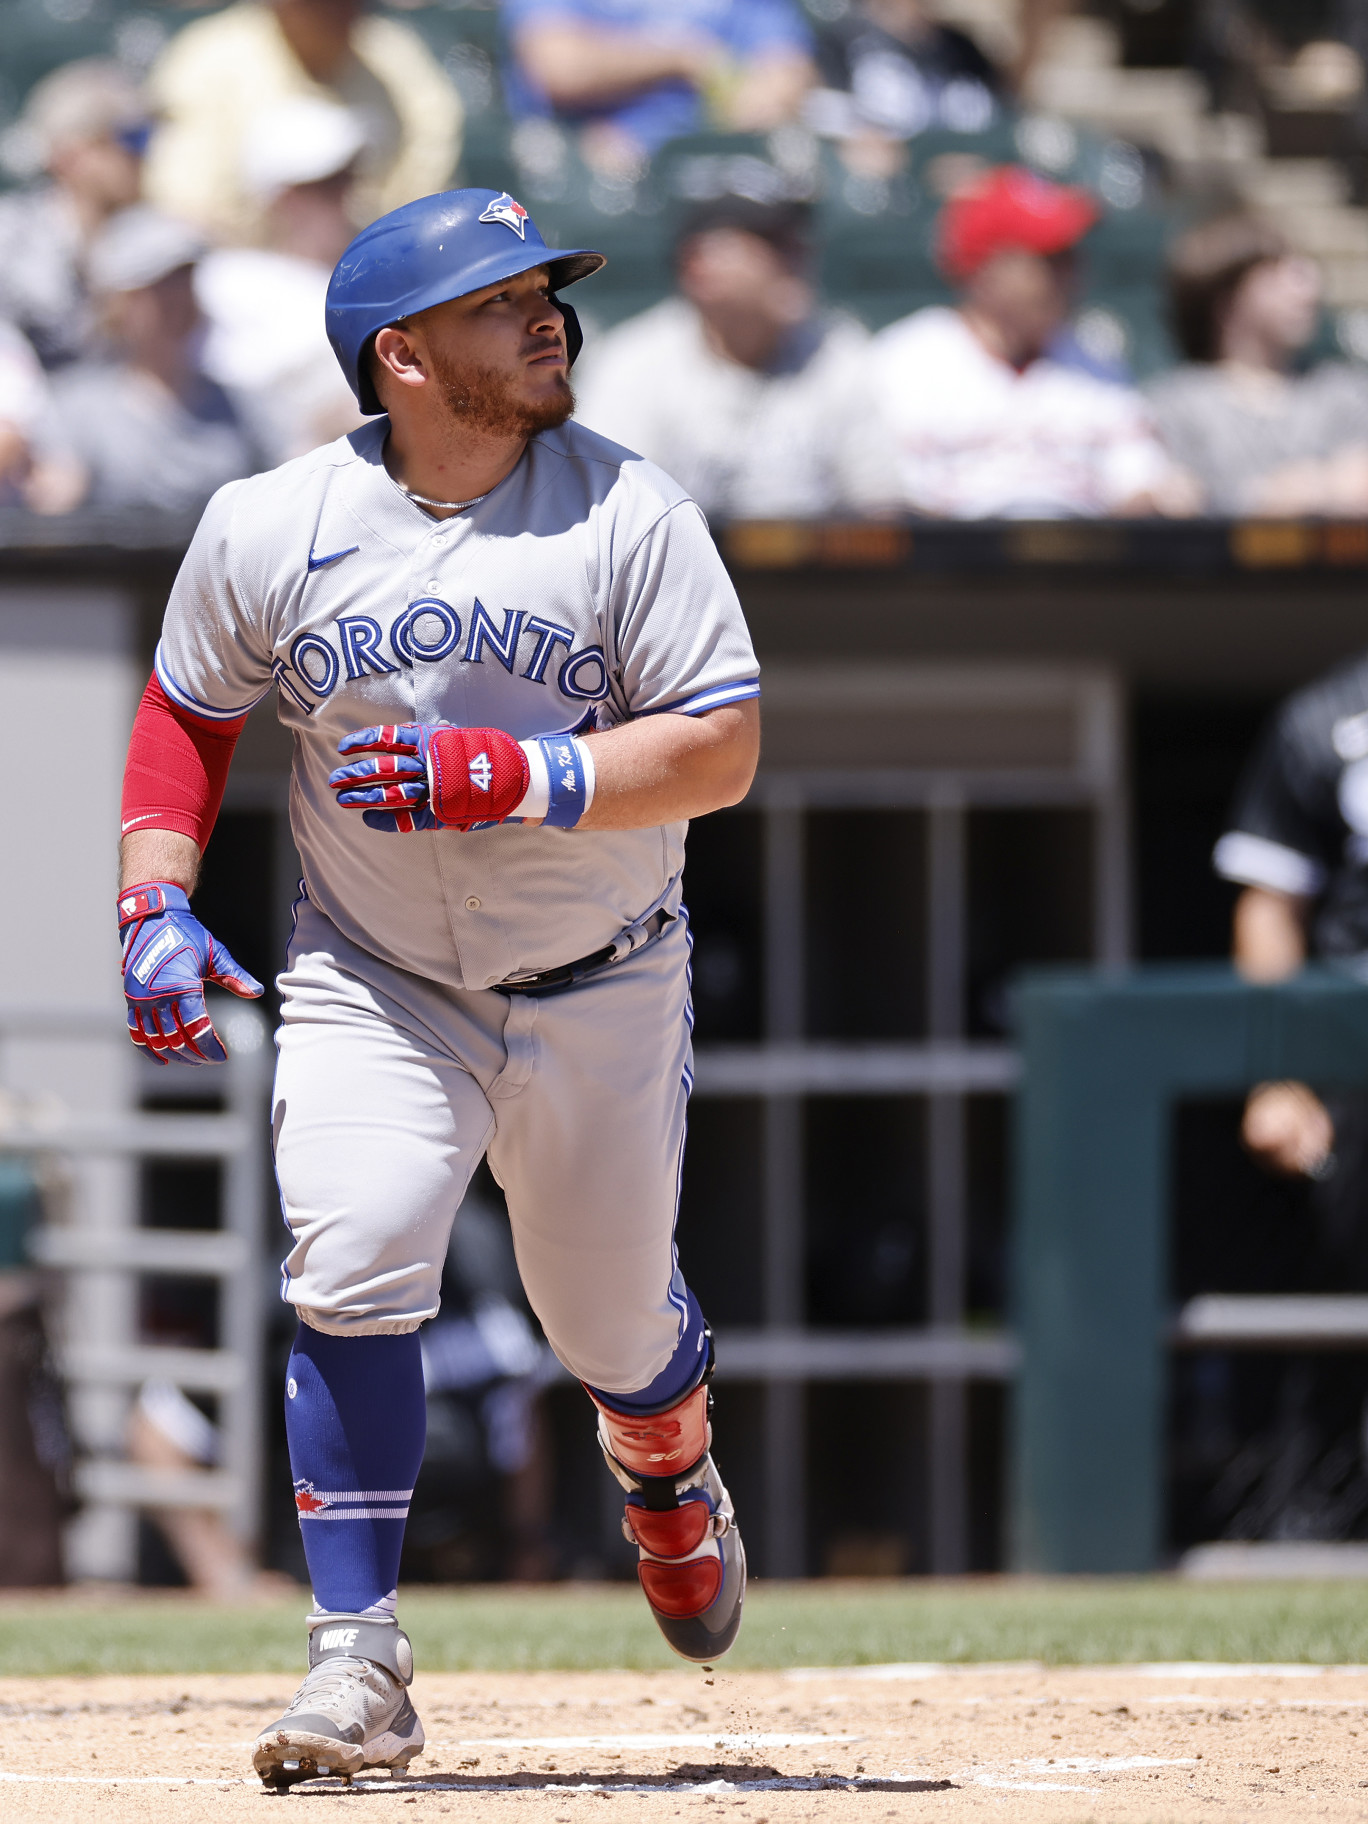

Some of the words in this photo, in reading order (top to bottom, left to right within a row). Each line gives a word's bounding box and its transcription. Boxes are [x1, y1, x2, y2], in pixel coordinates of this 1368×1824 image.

[271, 597, 610, 716] TORONTO
[468, 752, 493, 792] 44
[561, 769, 577, 793] Alex
[319, 1628, 360, 1652] NIKE
